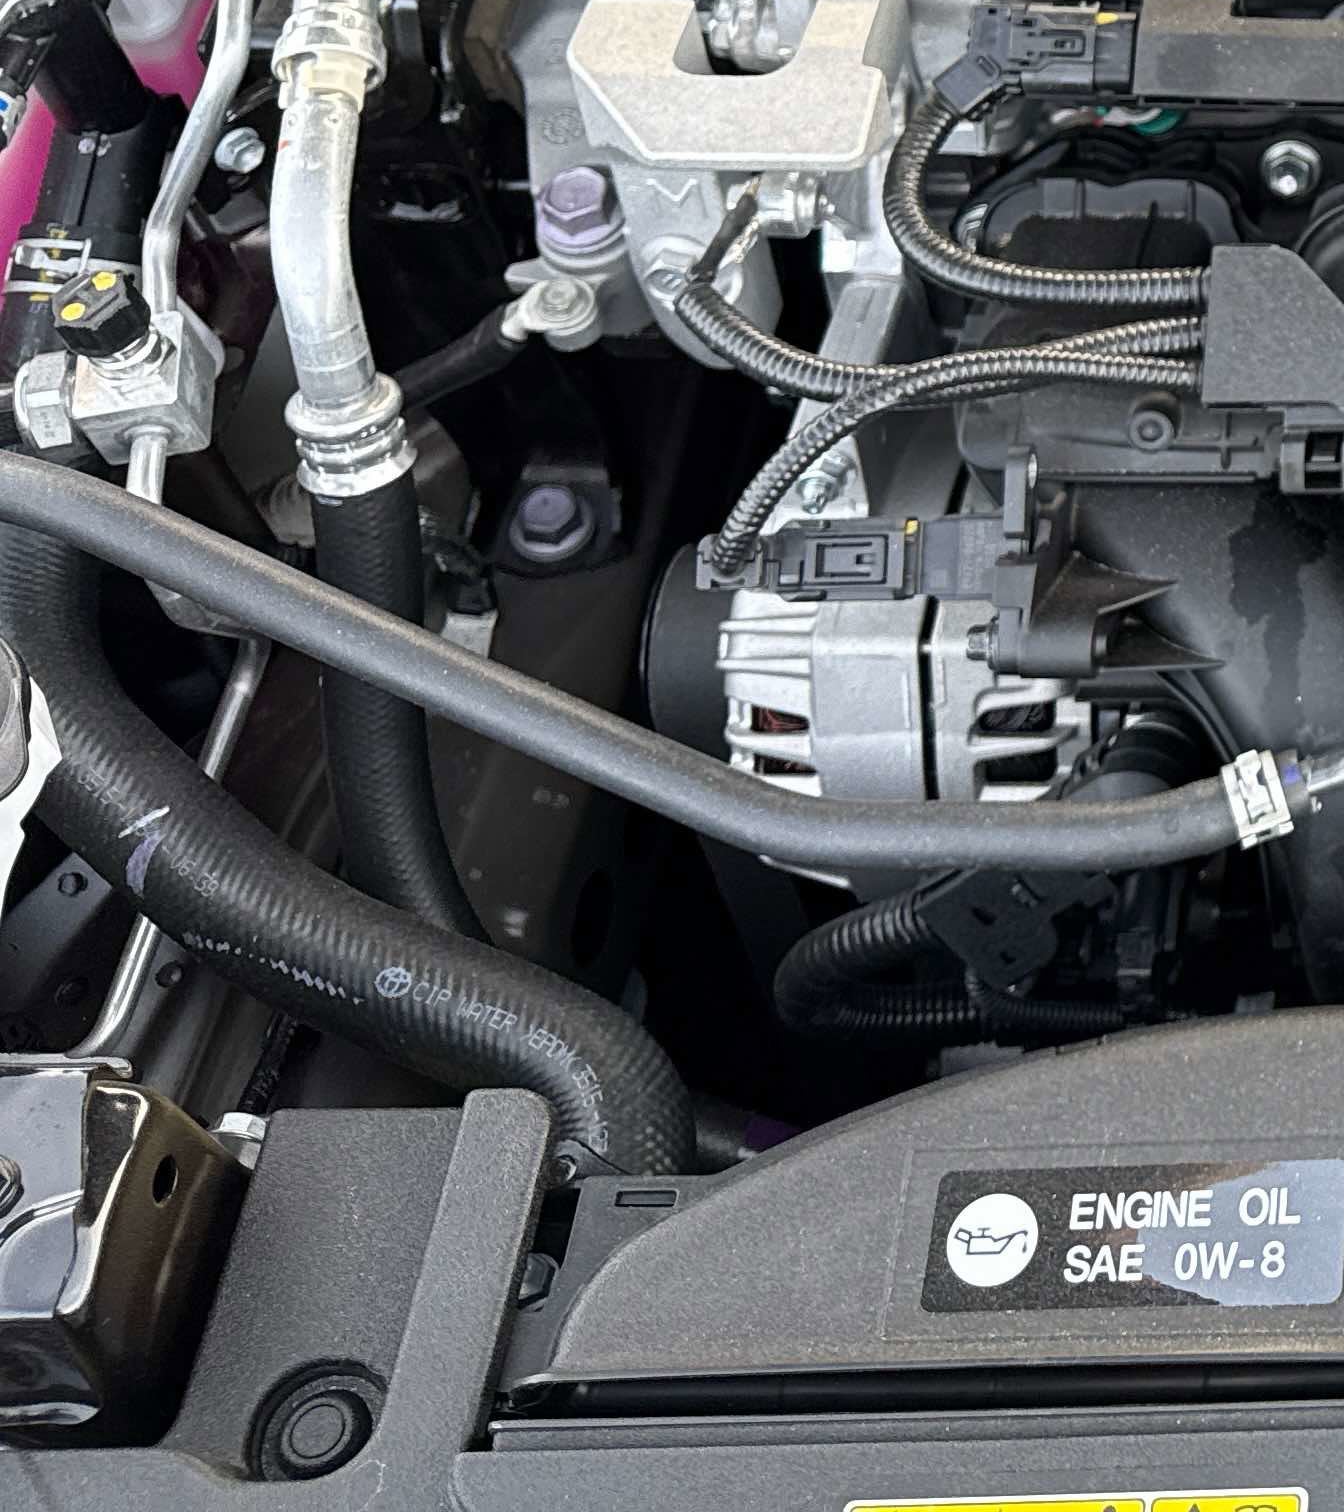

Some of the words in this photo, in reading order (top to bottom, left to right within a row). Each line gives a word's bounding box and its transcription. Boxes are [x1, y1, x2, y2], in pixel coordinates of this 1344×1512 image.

[456, 996, 518, 1033] WATER
[1069, 1190, 1214, 1230] ENGINE
[1237, 1187, 1301, 1227] OIL
[1063, 1243, 1145, 1284] SAE
[1174, 1240, 1286, 1281] 0W-8
